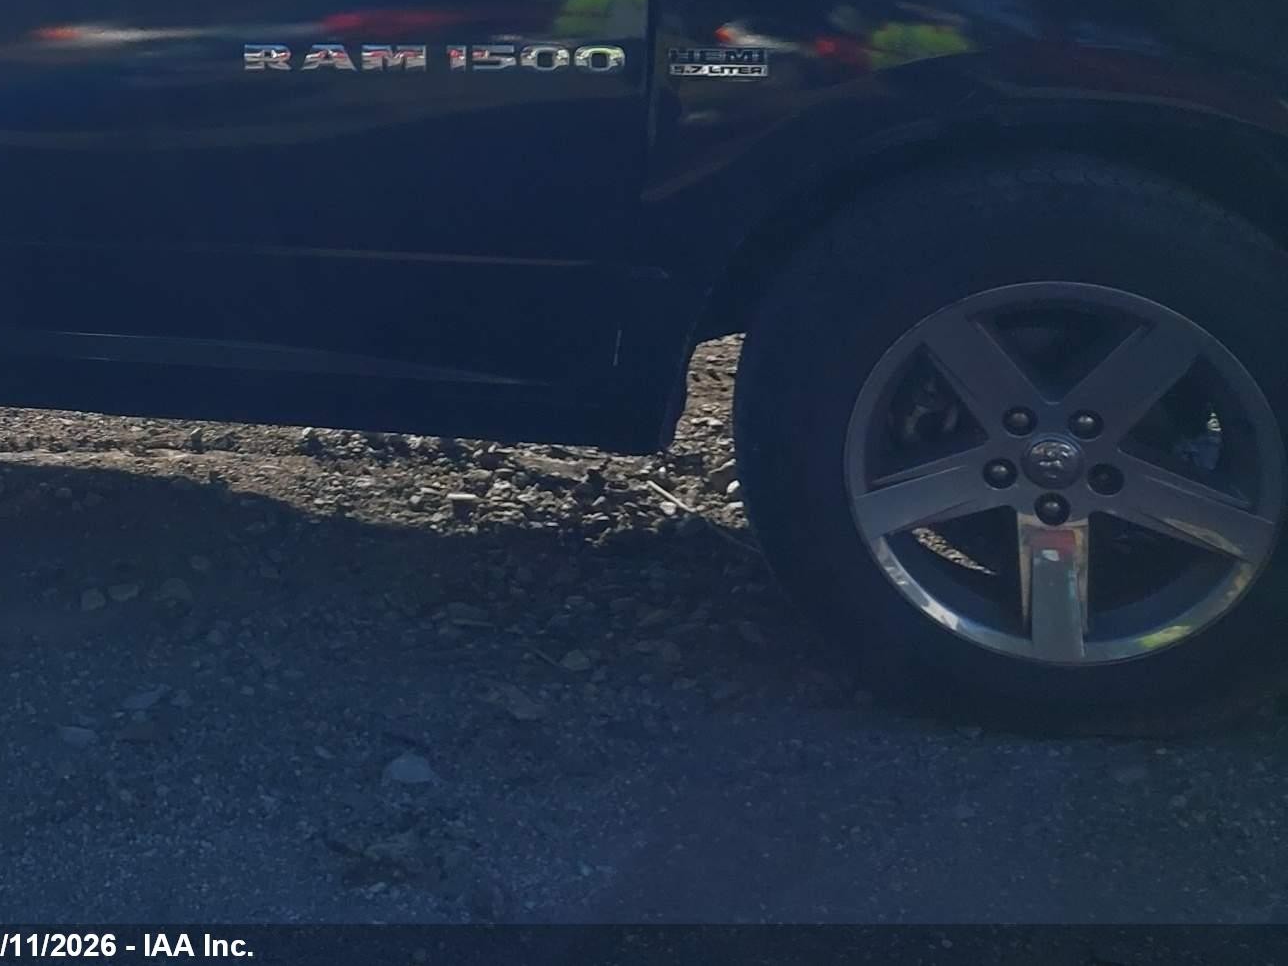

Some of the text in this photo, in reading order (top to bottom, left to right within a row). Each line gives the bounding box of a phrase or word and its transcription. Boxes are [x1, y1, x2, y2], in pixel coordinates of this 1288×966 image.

[243, 44, 626, 72] RAM 1500
[668, 48, 767, 64] HEMI
[708, 65, 764, 75] LITER
